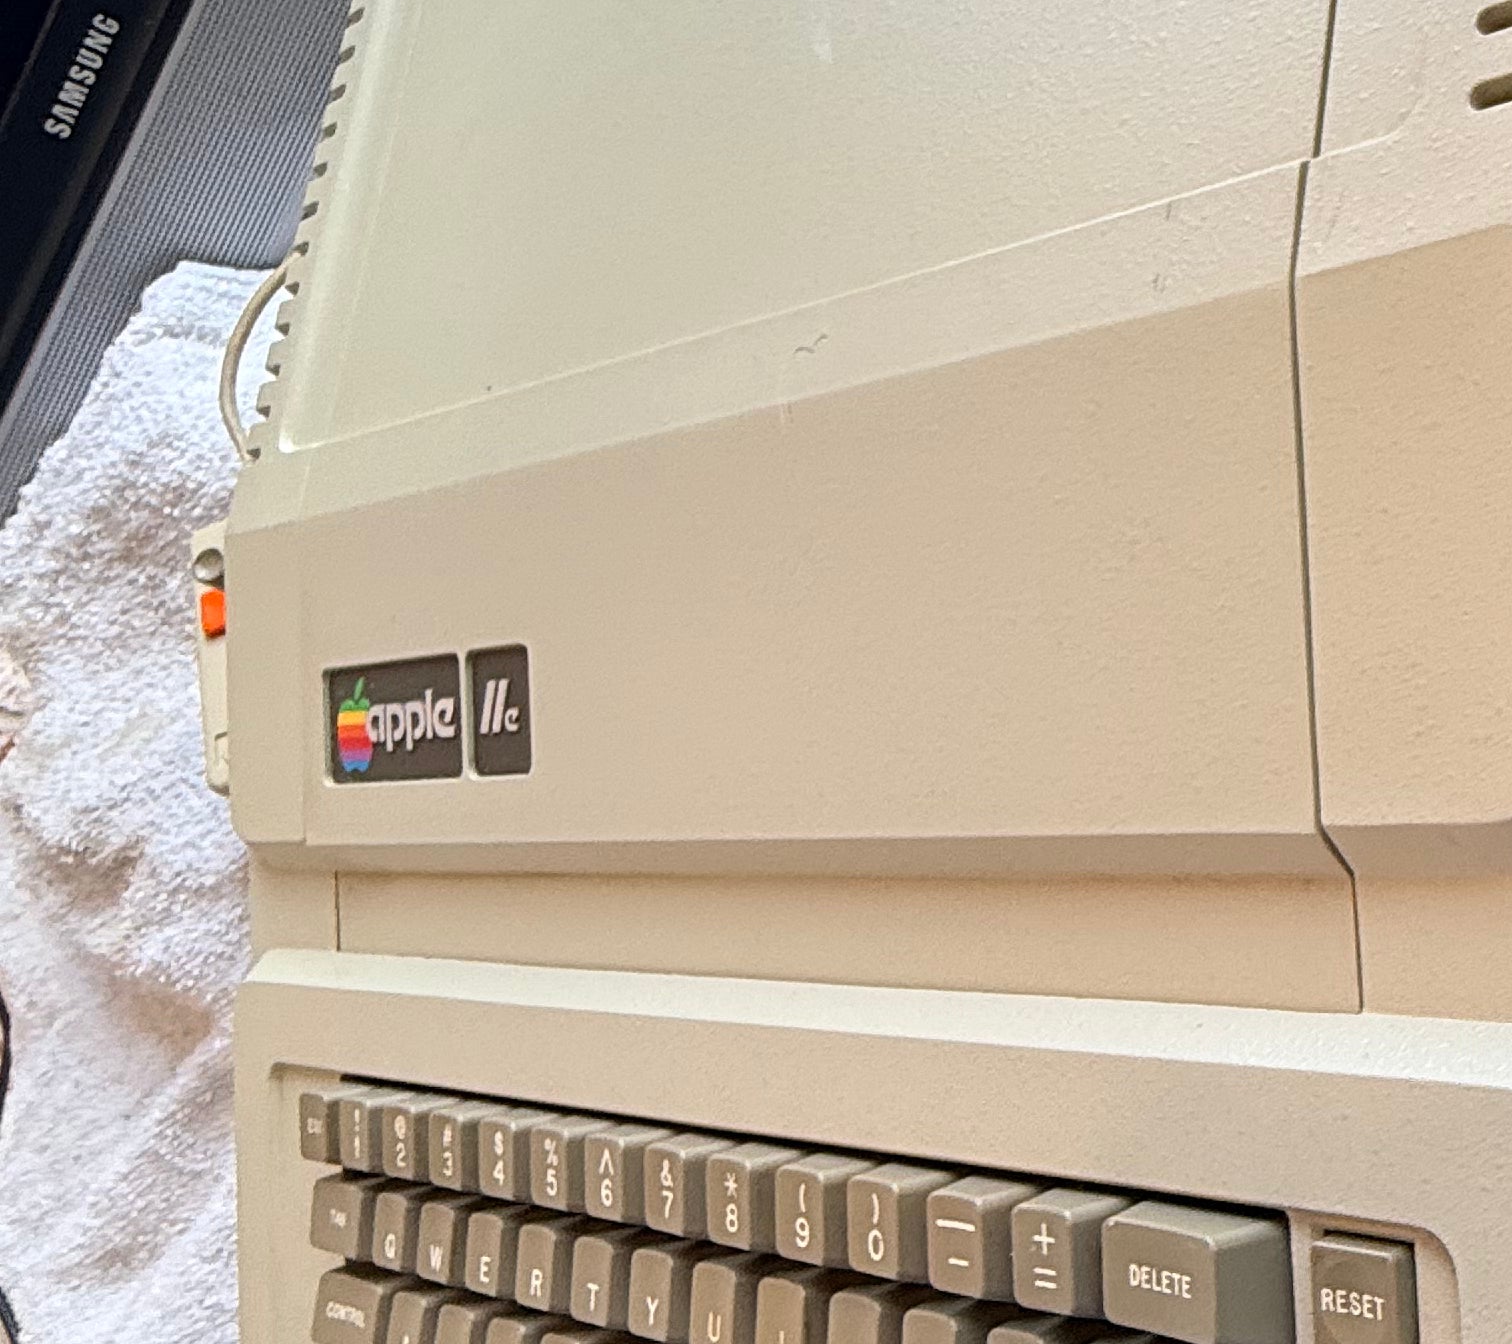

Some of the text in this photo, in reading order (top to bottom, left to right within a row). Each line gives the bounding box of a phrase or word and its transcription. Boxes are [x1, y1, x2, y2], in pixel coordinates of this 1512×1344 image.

[44, 13, 120, 139] SAMSUNG
[366, 687, 457, 752] apple
[396, 1142, 407, 1168] 2
[494, 1130, 504, 1156] $
[544, 1137, 559, 1166] %
[442, 1151, 453, 1177] 3
[492, 1159, 505, 1186] 4
[660, 1159, 674, 1188] &
[546, 1168, 558, 1197] 5
[600, 1178, 613, 1207] 6
[661, 1190, 674, 1219] 7
[725, 1203, 739, 1233] 8
[794, 1216, 810, 1248] 9
[1032, 1223, 1056, 1255] +
[430, 1244, 444, 1272] W
[479, 1255, 492, 1284] E
[530, 1268, 543, 1298] R
[1128, 1263, 1192, 1299] DELETE
[586, 1282, 600, 1311] T
[646, 1296, 659, 1326] Y
[1320, 1287, 1385, 1321] RESET
[707, 1311, 722, 1343] U
